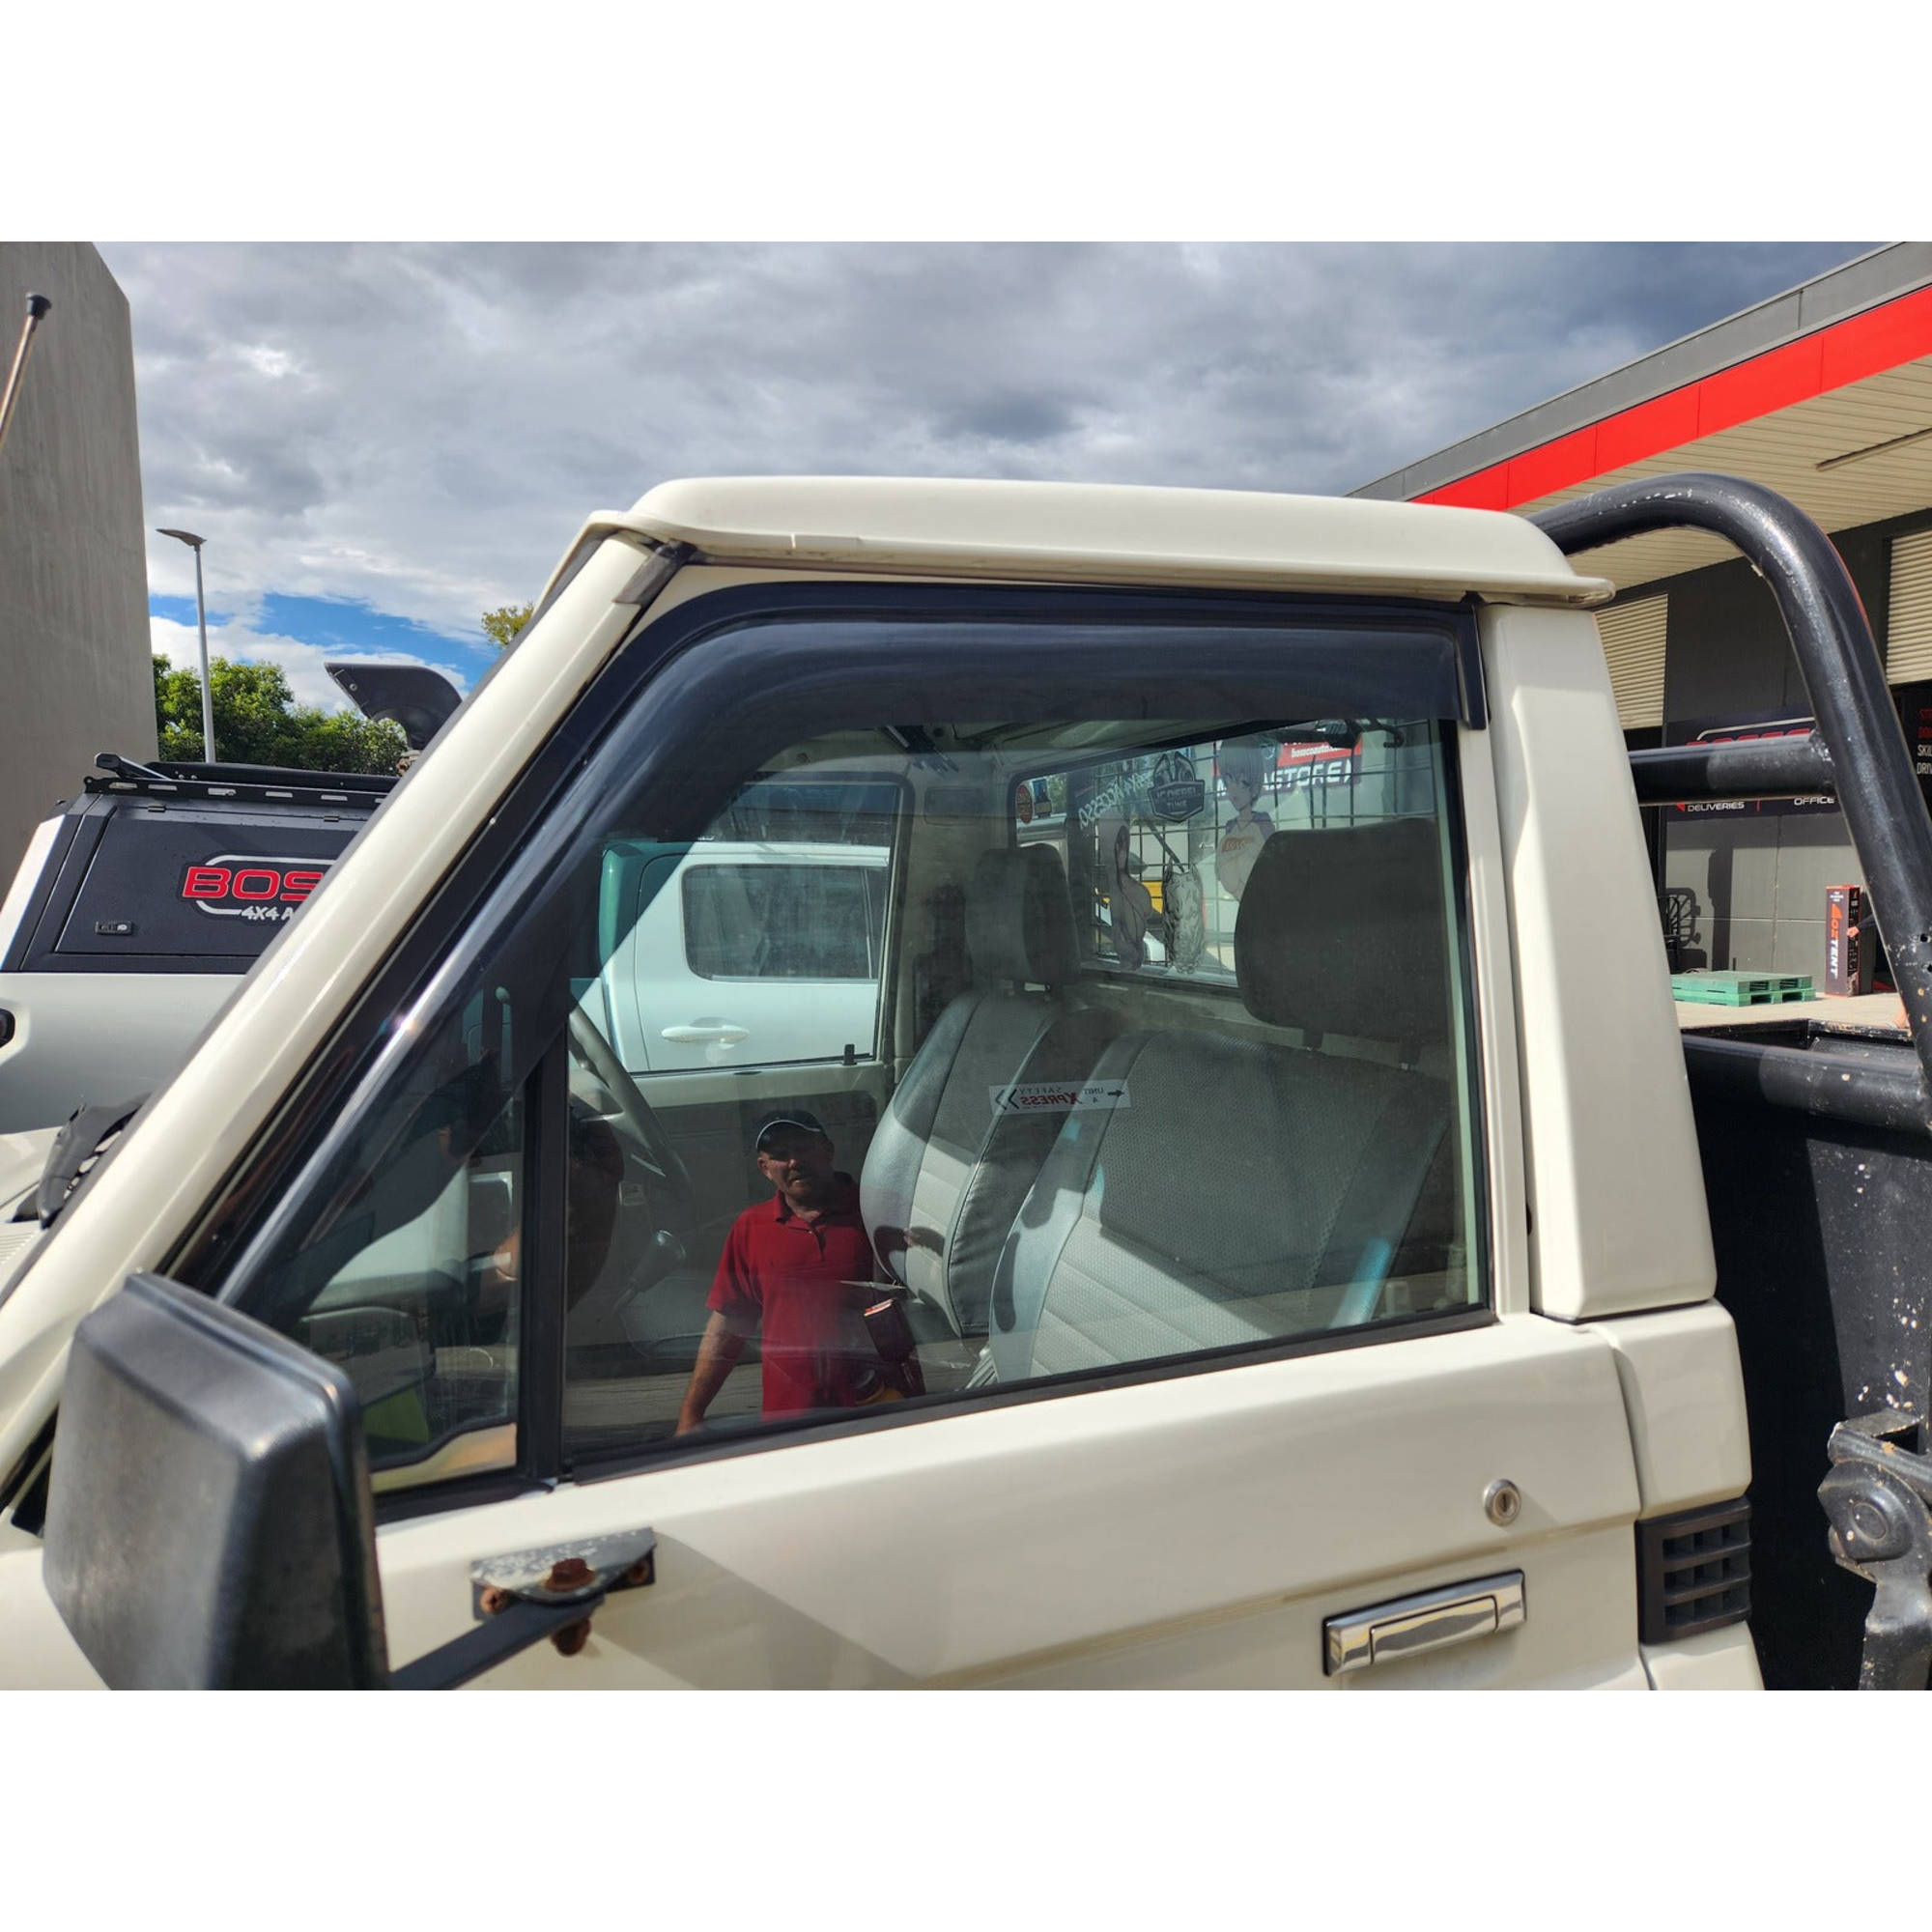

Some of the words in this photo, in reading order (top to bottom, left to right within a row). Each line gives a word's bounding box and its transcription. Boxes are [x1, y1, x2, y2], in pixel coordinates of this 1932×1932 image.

[1688, 801, 1746, 812] DELIVERIES
[1794, 796, 1835, 807] OFFICE
[183, 866, 325, 901] BOS
